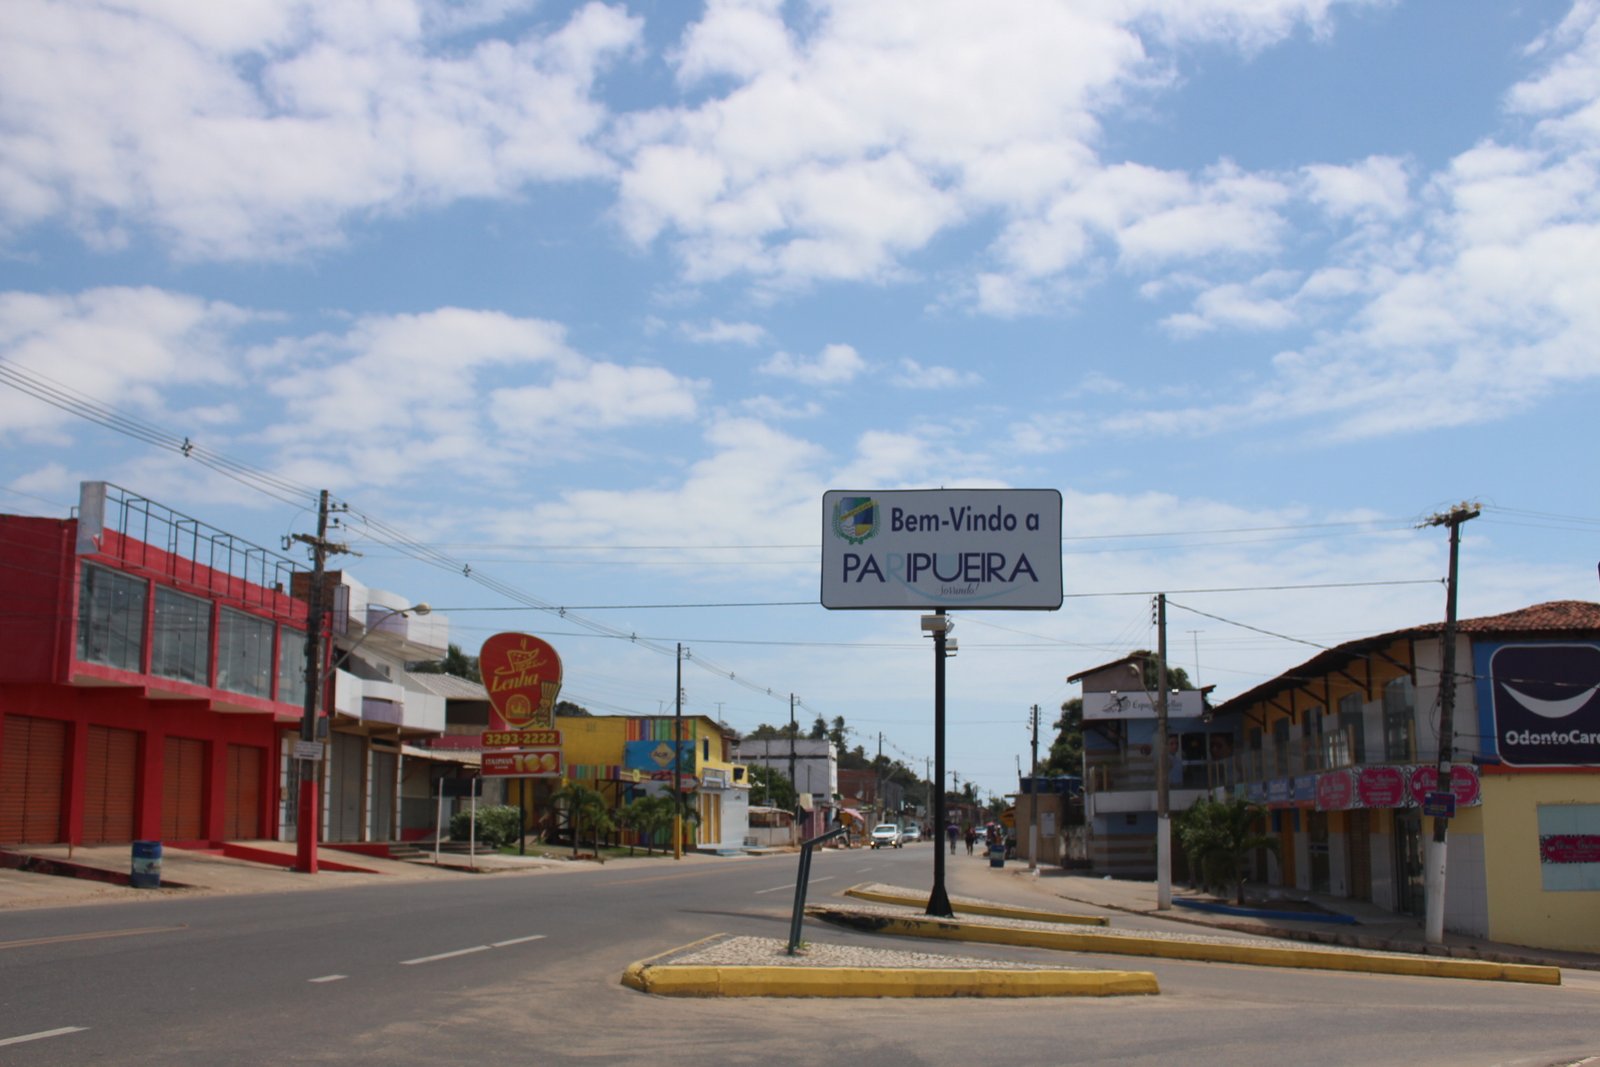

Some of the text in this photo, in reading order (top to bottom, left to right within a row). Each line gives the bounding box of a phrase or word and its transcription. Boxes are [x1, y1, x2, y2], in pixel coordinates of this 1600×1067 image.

[891, 505, 1039, 532] Bem-Vindo a
[843, 552, 1039, 583] PARIPUEIRA
[491, 671, 539, 693] Lenha
[485, 733, 556, 745] 3293-2222
